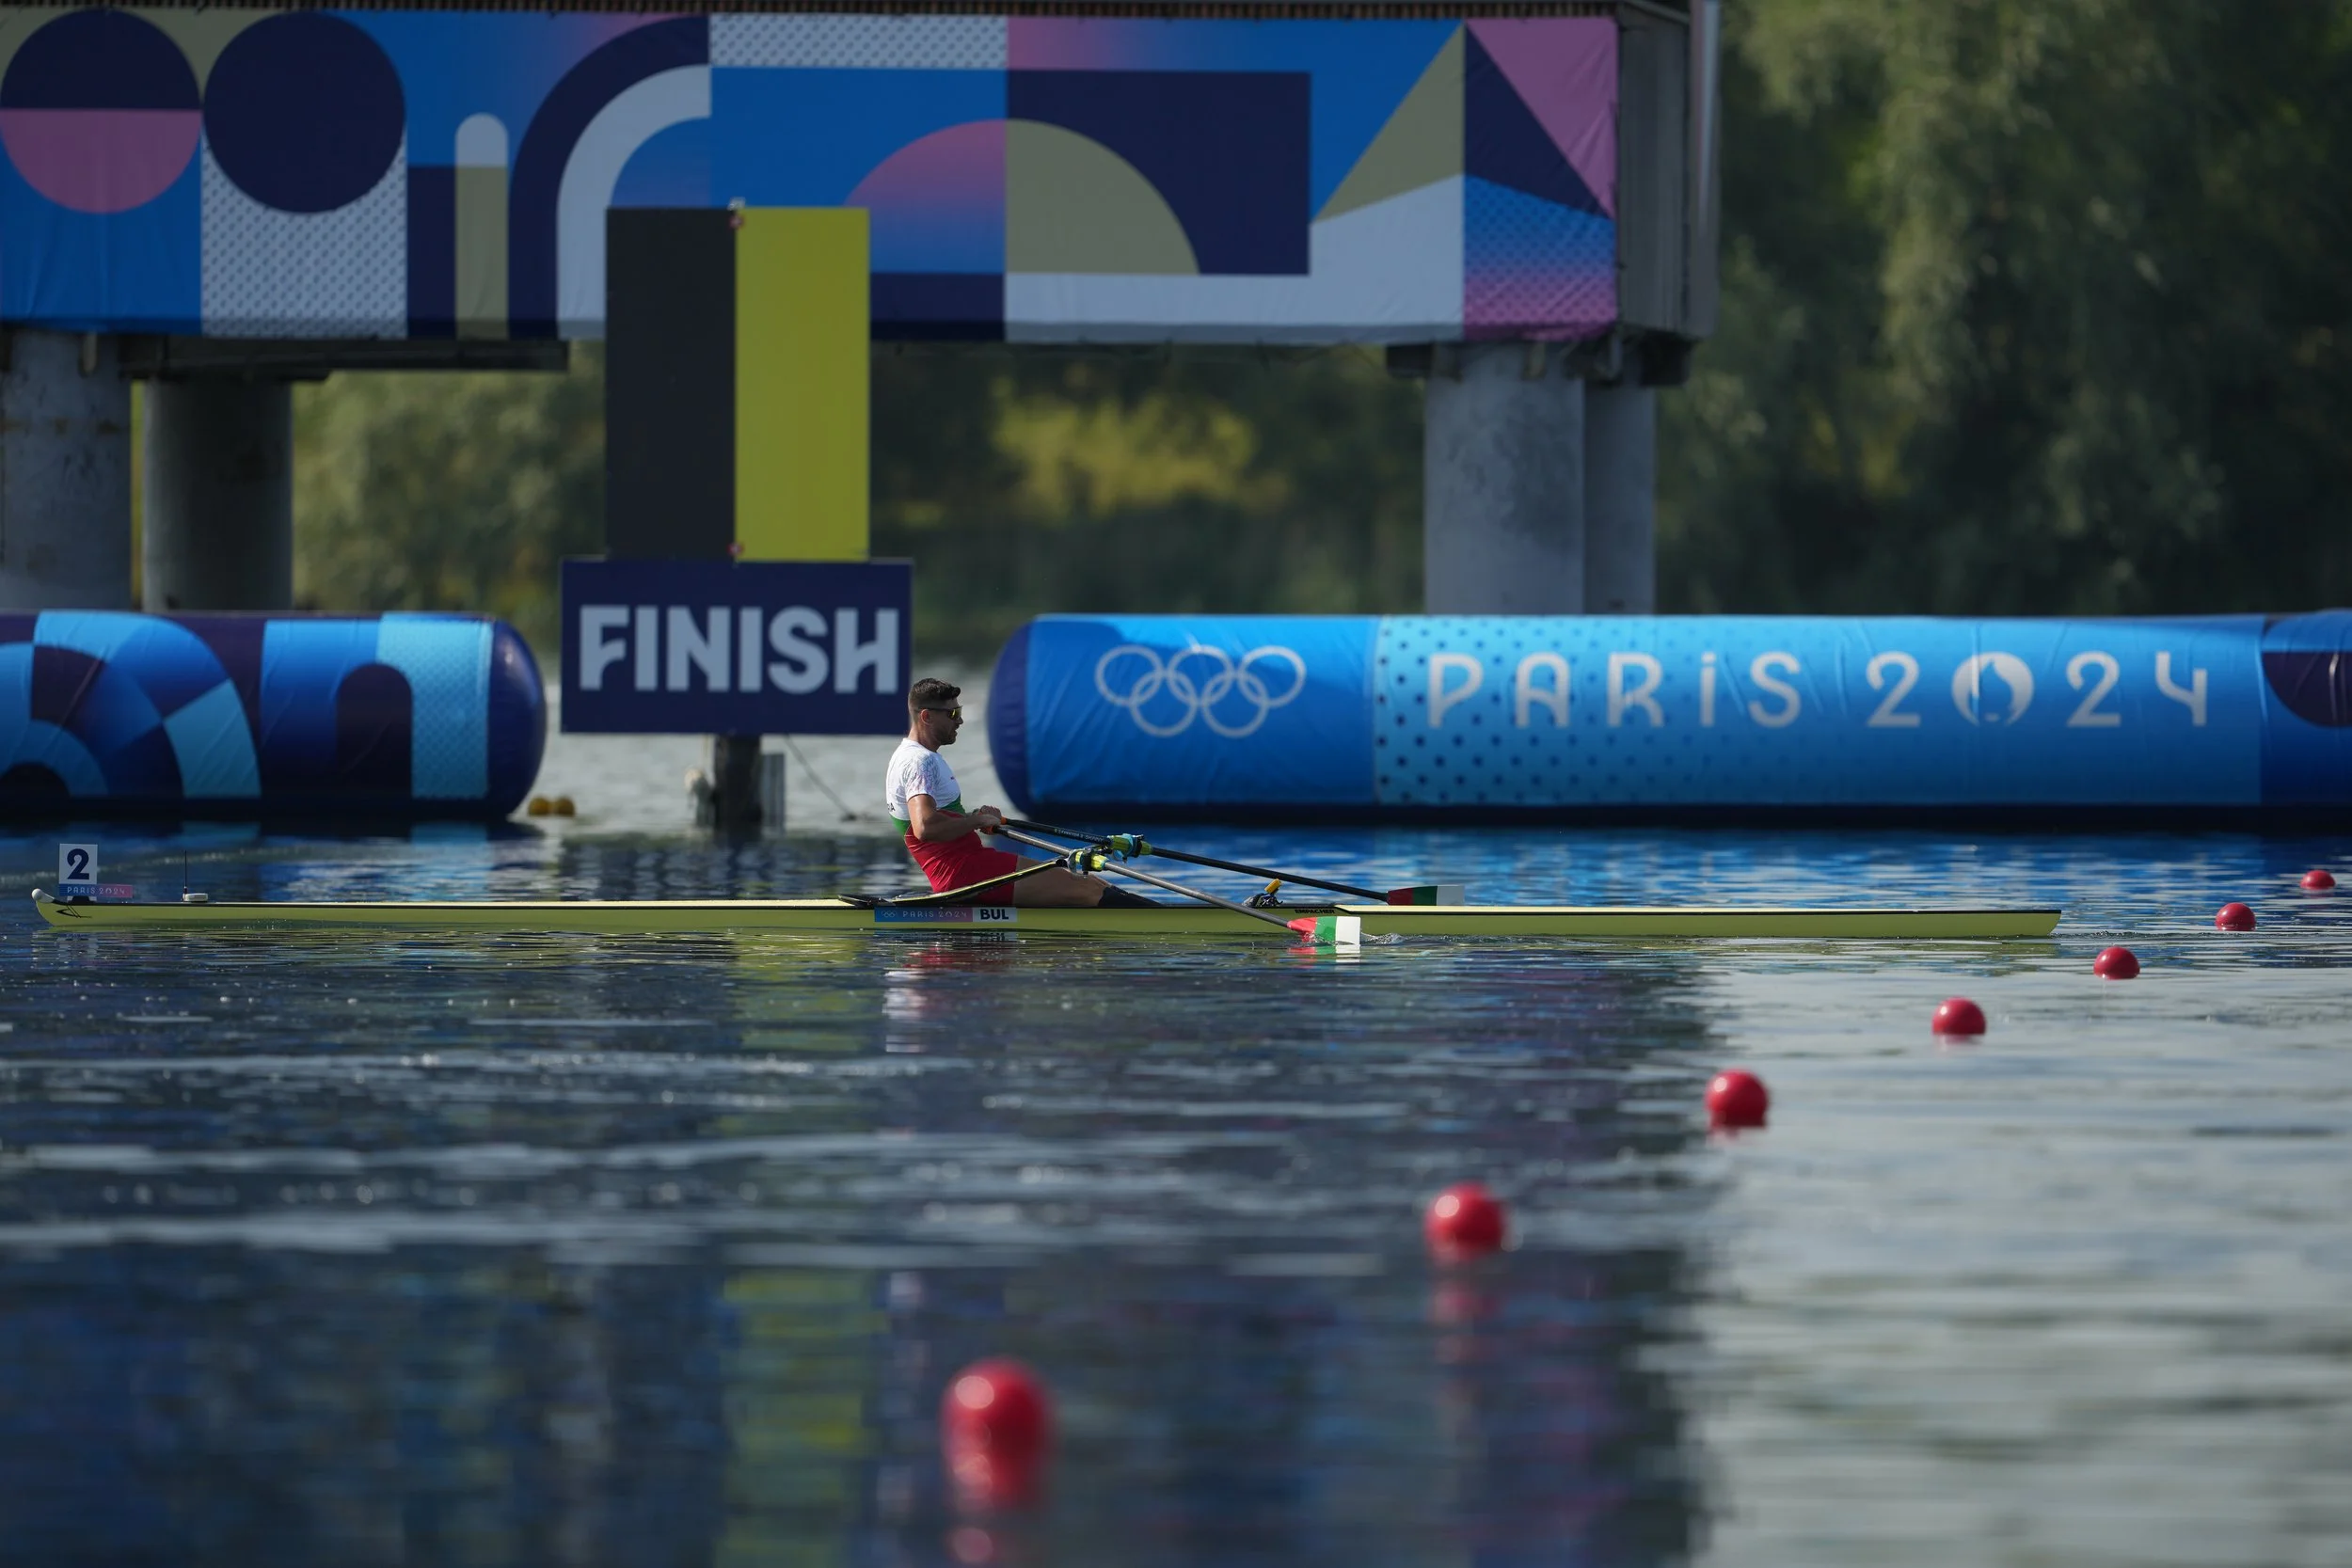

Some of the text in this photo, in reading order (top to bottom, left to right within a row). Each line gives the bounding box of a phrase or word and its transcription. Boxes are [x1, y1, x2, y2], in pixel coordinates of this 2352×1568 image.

[580, 604, 899, 695] FINISH
[1865, 651, 2208, 728] 2024
[67, 848, 90, 880] 2
[980, 909, 1009, 920] BUL
